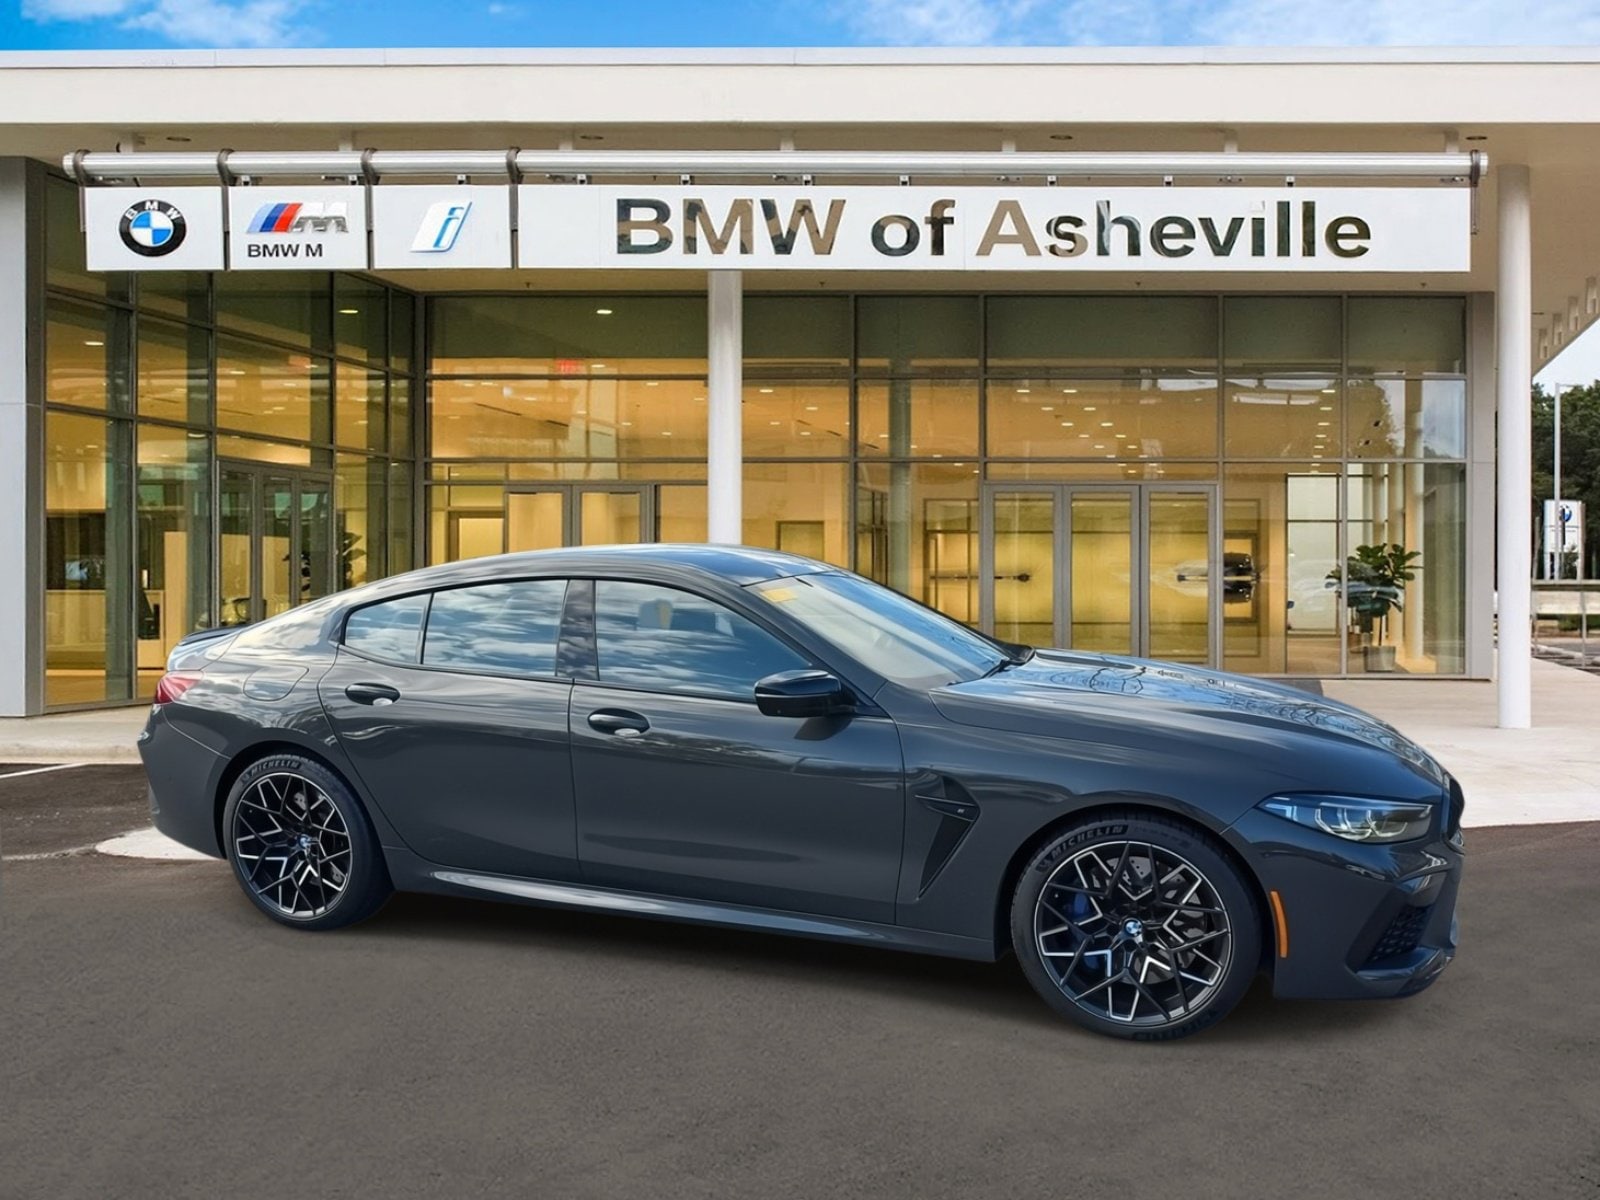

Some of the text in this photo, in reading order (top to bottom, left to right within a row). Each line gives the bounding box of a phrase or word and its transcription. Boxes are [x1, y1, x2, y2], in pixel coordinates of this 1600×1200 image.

[124, 200, 181, 220] BMW
[616, 198, 1372, 259] BMW of Asheville
[247, 243, 323, 258] BMW M
[251, 760, 300, 775] MICHELIN
[1051, 825, 1124, 859] MICHELIN
